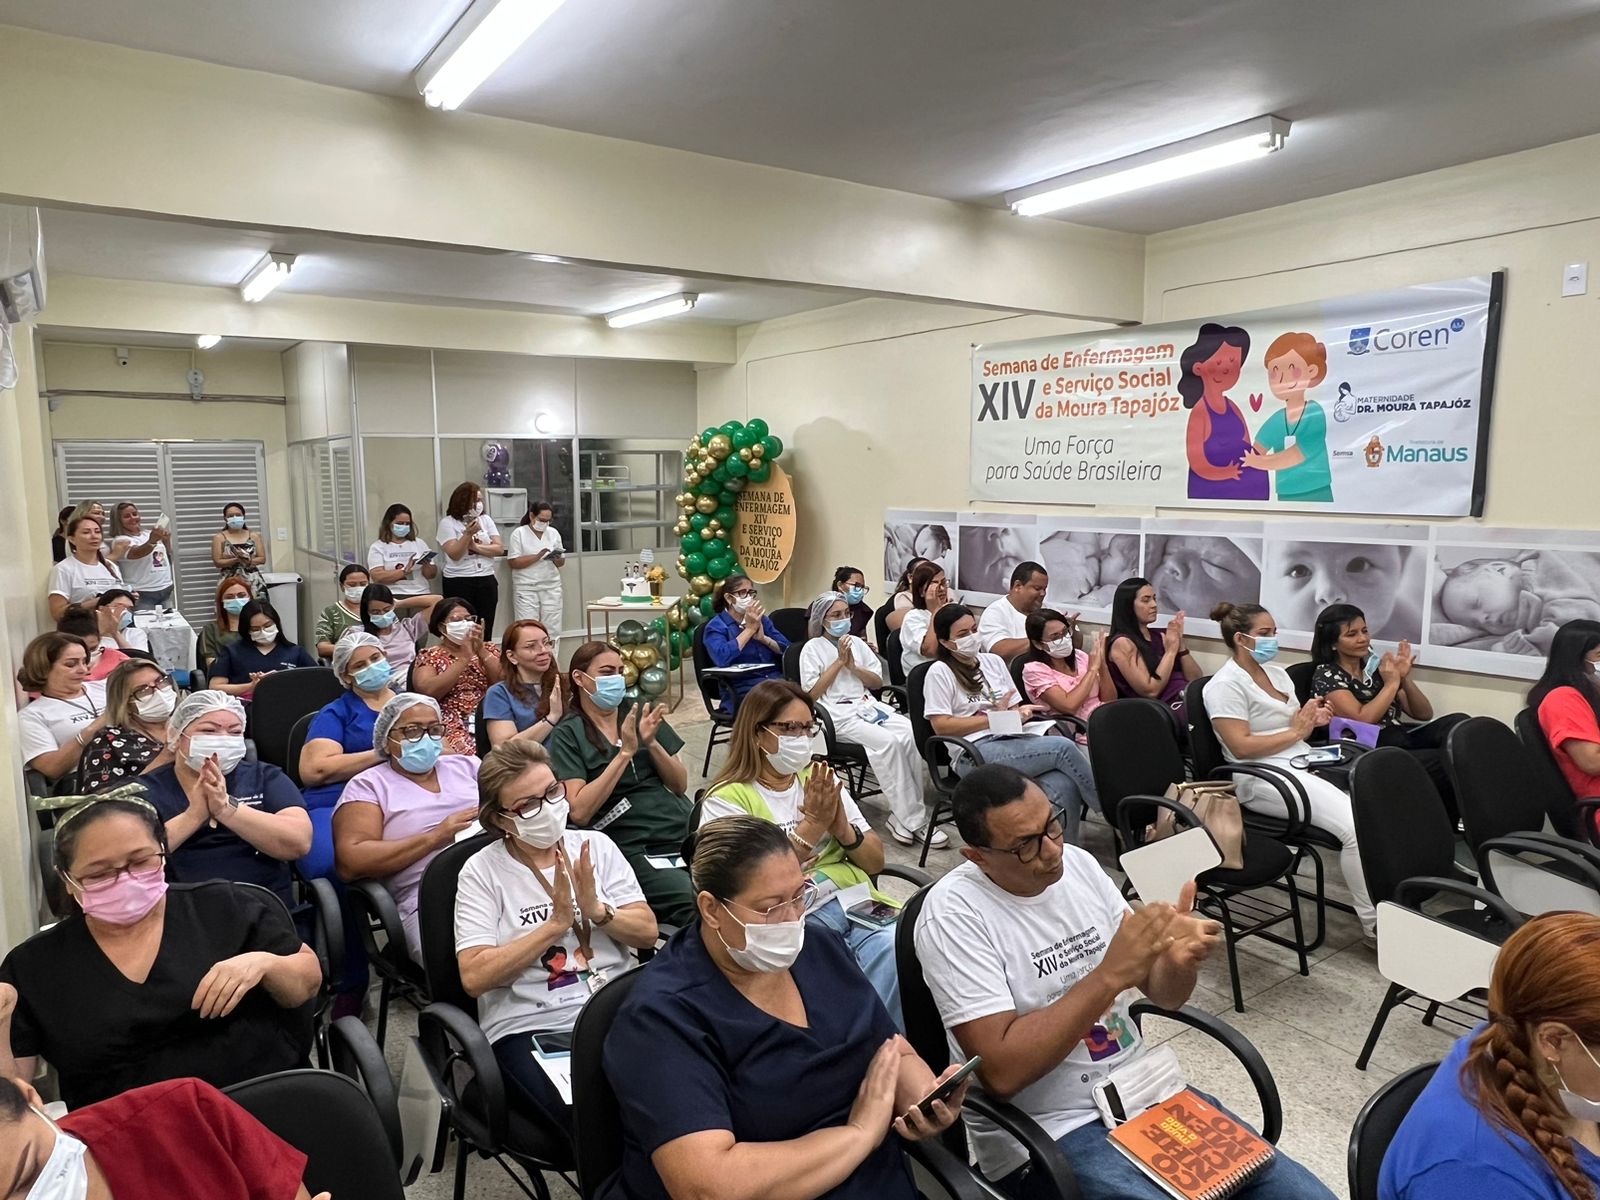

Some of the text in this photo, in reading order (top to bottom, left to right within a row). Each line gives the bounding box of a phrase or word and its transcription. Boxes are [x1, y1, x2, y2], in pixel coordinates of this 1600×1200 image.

[1373, 327, 1449, 351] Coren
[983, 343, 1174, 377] Semana de Enfermagem
[1042, 367, 1172, 397] e Serviço Social
[977, 379, 1036, 421] XIV
[1035, 392, 1180, 419] da Moura Tapajóz
[1357, 394, 1415, 403] MATERNIDADE
[1357, 397, 1472, 413] DR. MOURA TAPAJÓZ
[1024, 435, 1114, 460] Uma Força
[1386, 445, 1468, 463] Manaus
[985, 459, 1162, 484] para Saúde Brasileira
[736, 491, 784, 503] SEMANA DE
[735, 501, 791, 515] ENFERMAGEM
[754, 514, 768, 524] XIV
[742, 524, 782, 538] E SERVIÇO
[749, 536, 777, 548] SOCIAL
[740, 545, 782, 560] DA MOURA
[520, 903, 548, 914] Semana
[519, 908, 548, 926] XIV
[1054, 942, 1063, 950] de
[1033, 954, 1058, 979] XIV
[1060, 961, 1069, 969] da
